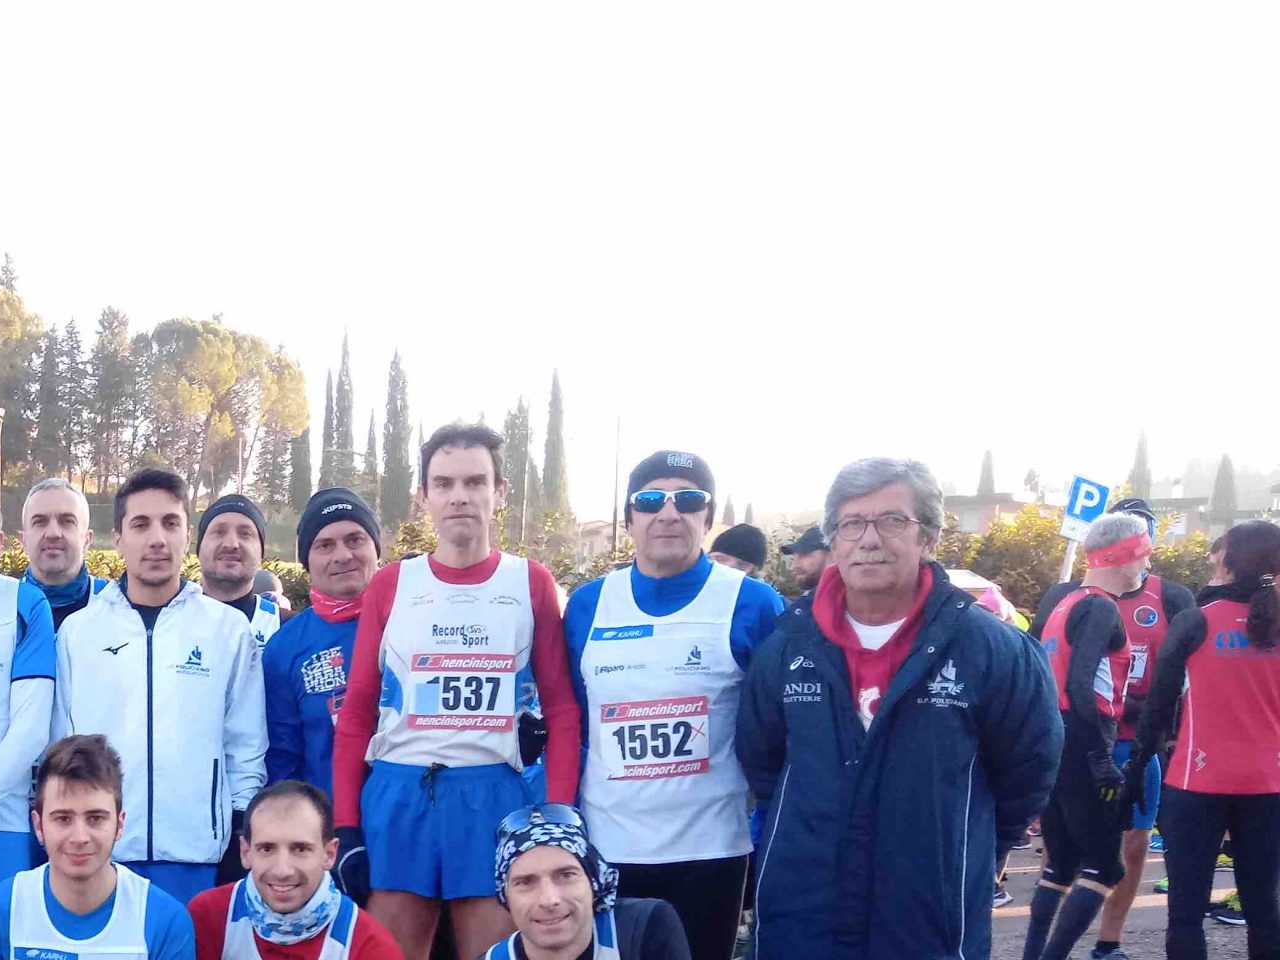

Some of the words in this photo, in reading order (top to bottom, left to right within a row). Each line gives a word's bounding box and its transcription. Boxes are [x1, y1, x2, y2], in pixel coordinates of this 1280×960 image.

[1073, 482, 1101, 515] P
[432, 624, 465, 637] Record
[462, 634, 489, 648] Sport
[440, 656, 513, 670] nencinisport
[426, 676, 501, 711] 537
[627, 700, 703, 717] nencinisport
[415, 715, 507, 727] nencinisport.com
[612, 720, 693, 761] 1552
